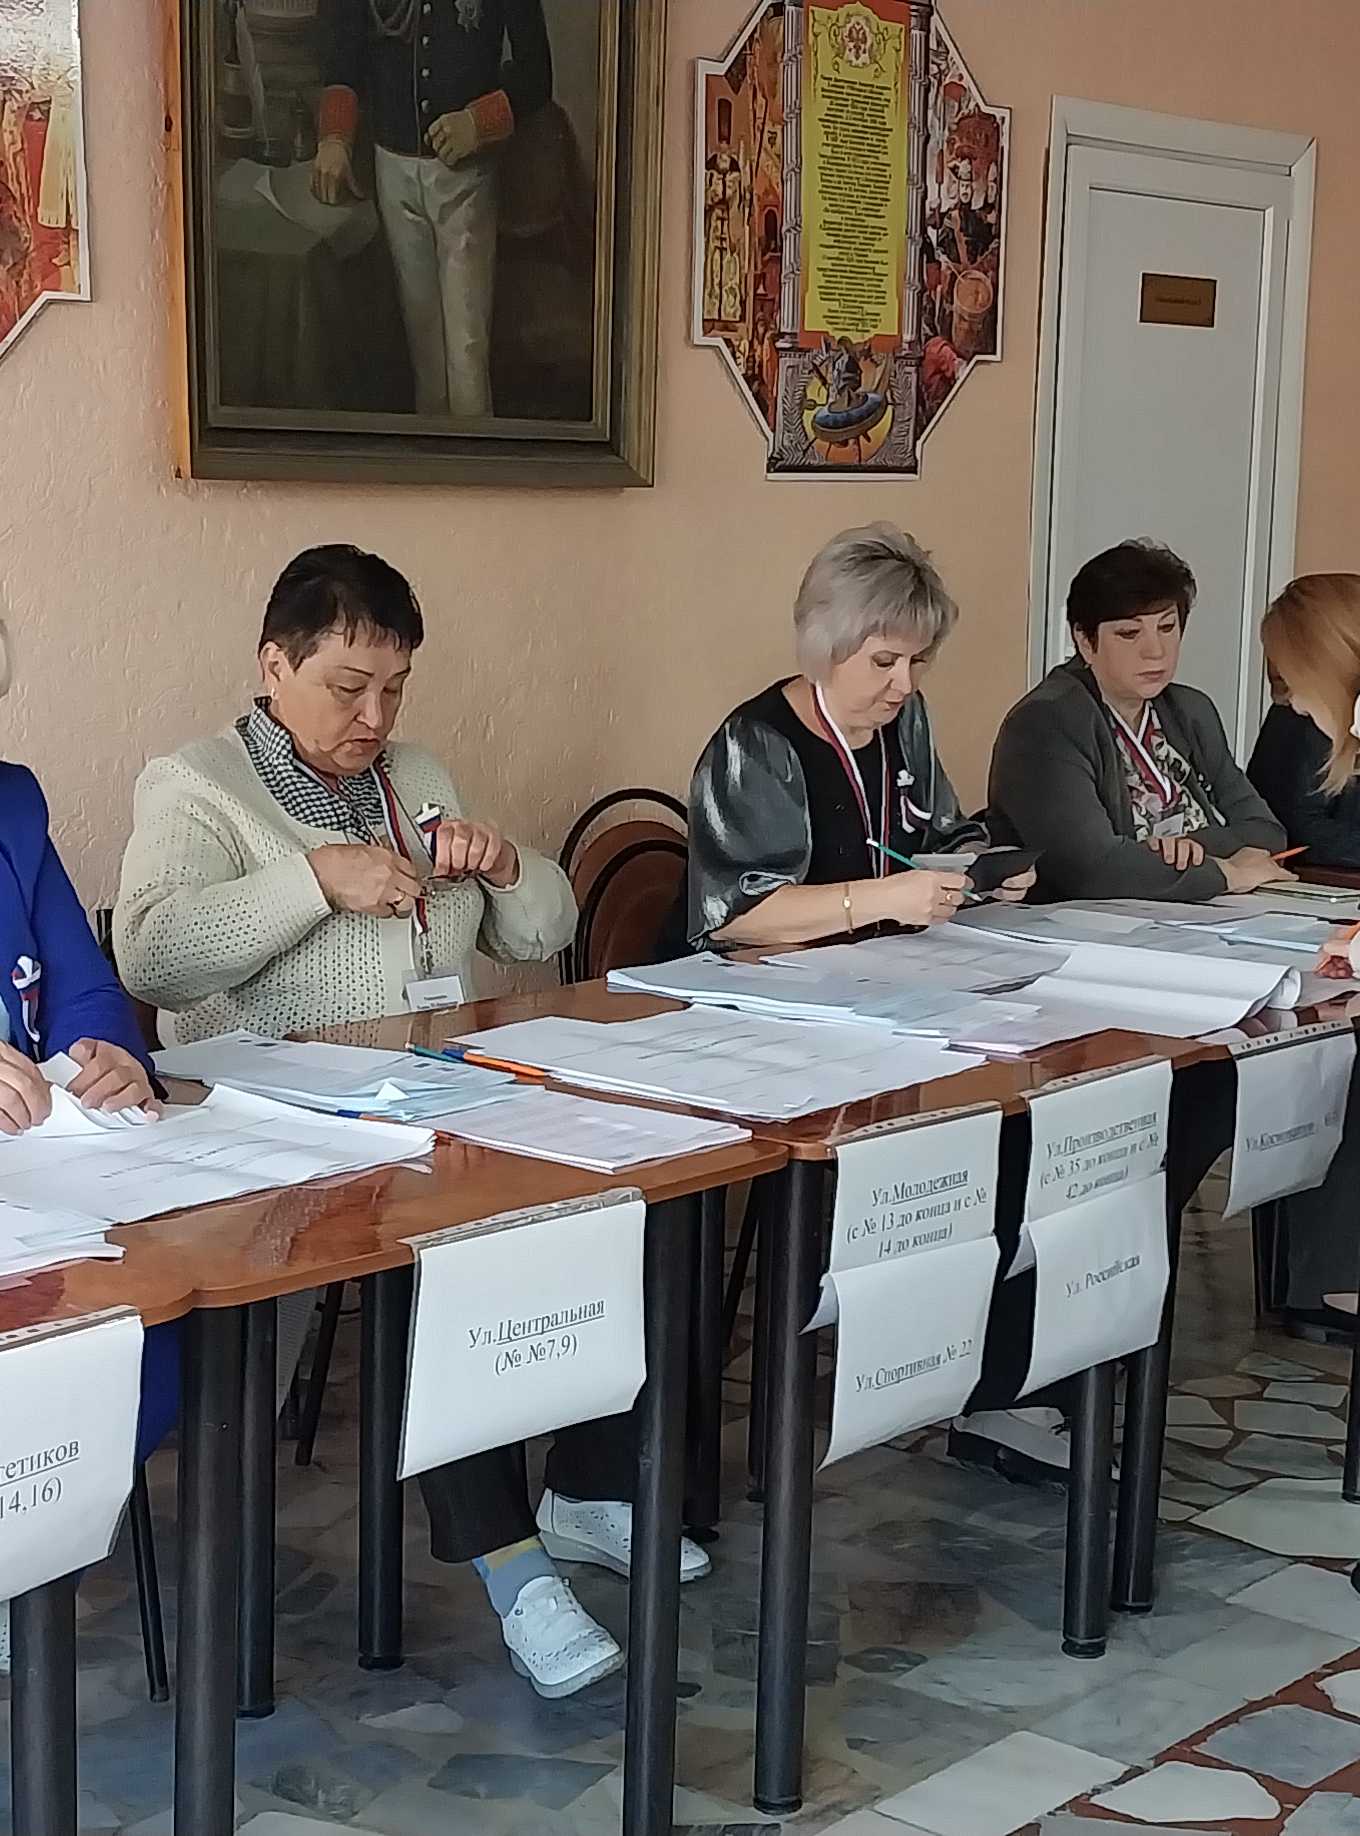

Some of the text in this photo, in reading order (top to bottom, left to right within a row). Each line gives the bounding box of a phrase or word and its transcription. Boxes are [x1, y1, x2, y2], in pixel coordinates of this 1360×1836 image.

[871, 1169, 969, 1208] Ул.Молодежная
[846, 1187, 987, 1244] (с № 13 до конца и с №
[878, 1222, 953, 1259] 14 до конца)
[468, 1300, 605, 1349] Ул.Центральная
[855, 1339, 973, 1393] Ул.Спортивная № 22
